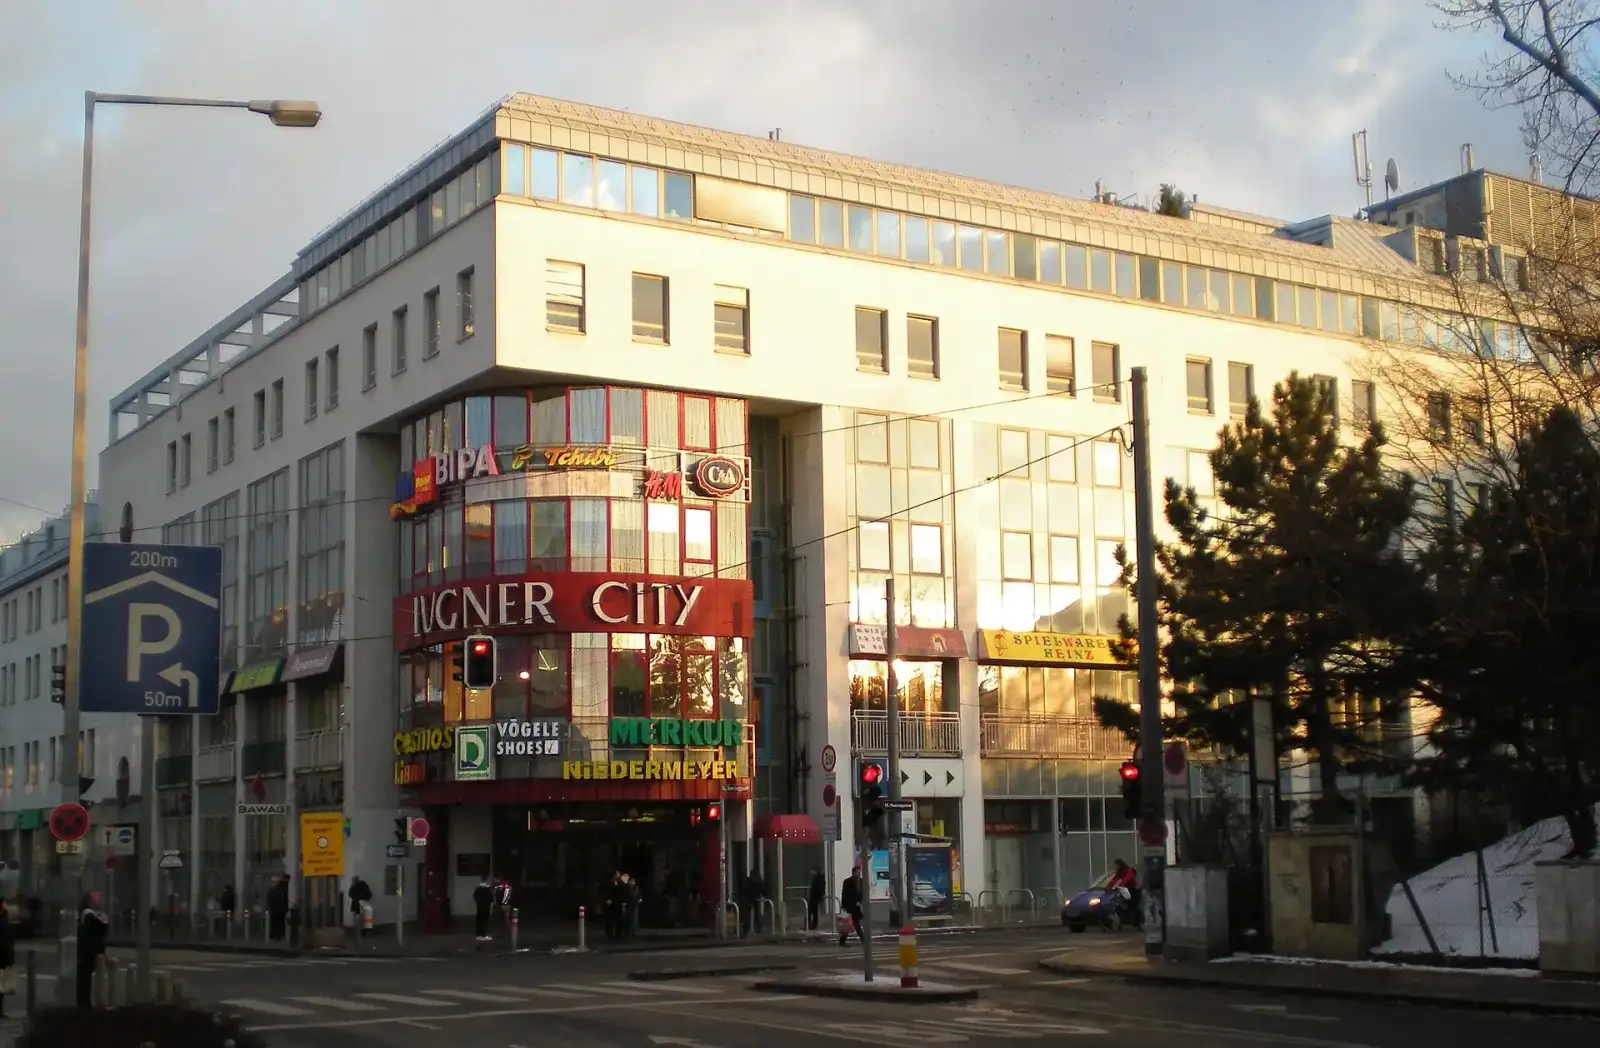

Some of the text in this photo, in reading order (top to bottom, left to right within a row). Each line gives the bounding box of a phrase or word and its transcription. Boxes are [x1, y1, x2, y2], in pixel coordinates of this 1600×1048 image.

[435, 443, 498, 485] BIPA
[707, 466, 735, 484] C&A
[130, 550, 178, 568] 200m
[126, 602, 182, 682] P
[1013, 634, 1114, 649] SPIELWARE
[1043, 648, 1094, 661] HEINZ
[143, 690, 182, 707] 50m
[609, 717, 743, 746] MERKUR
[496, 740, 543, 755] SHOES
[238, 804, 286, 815] BAWAG
